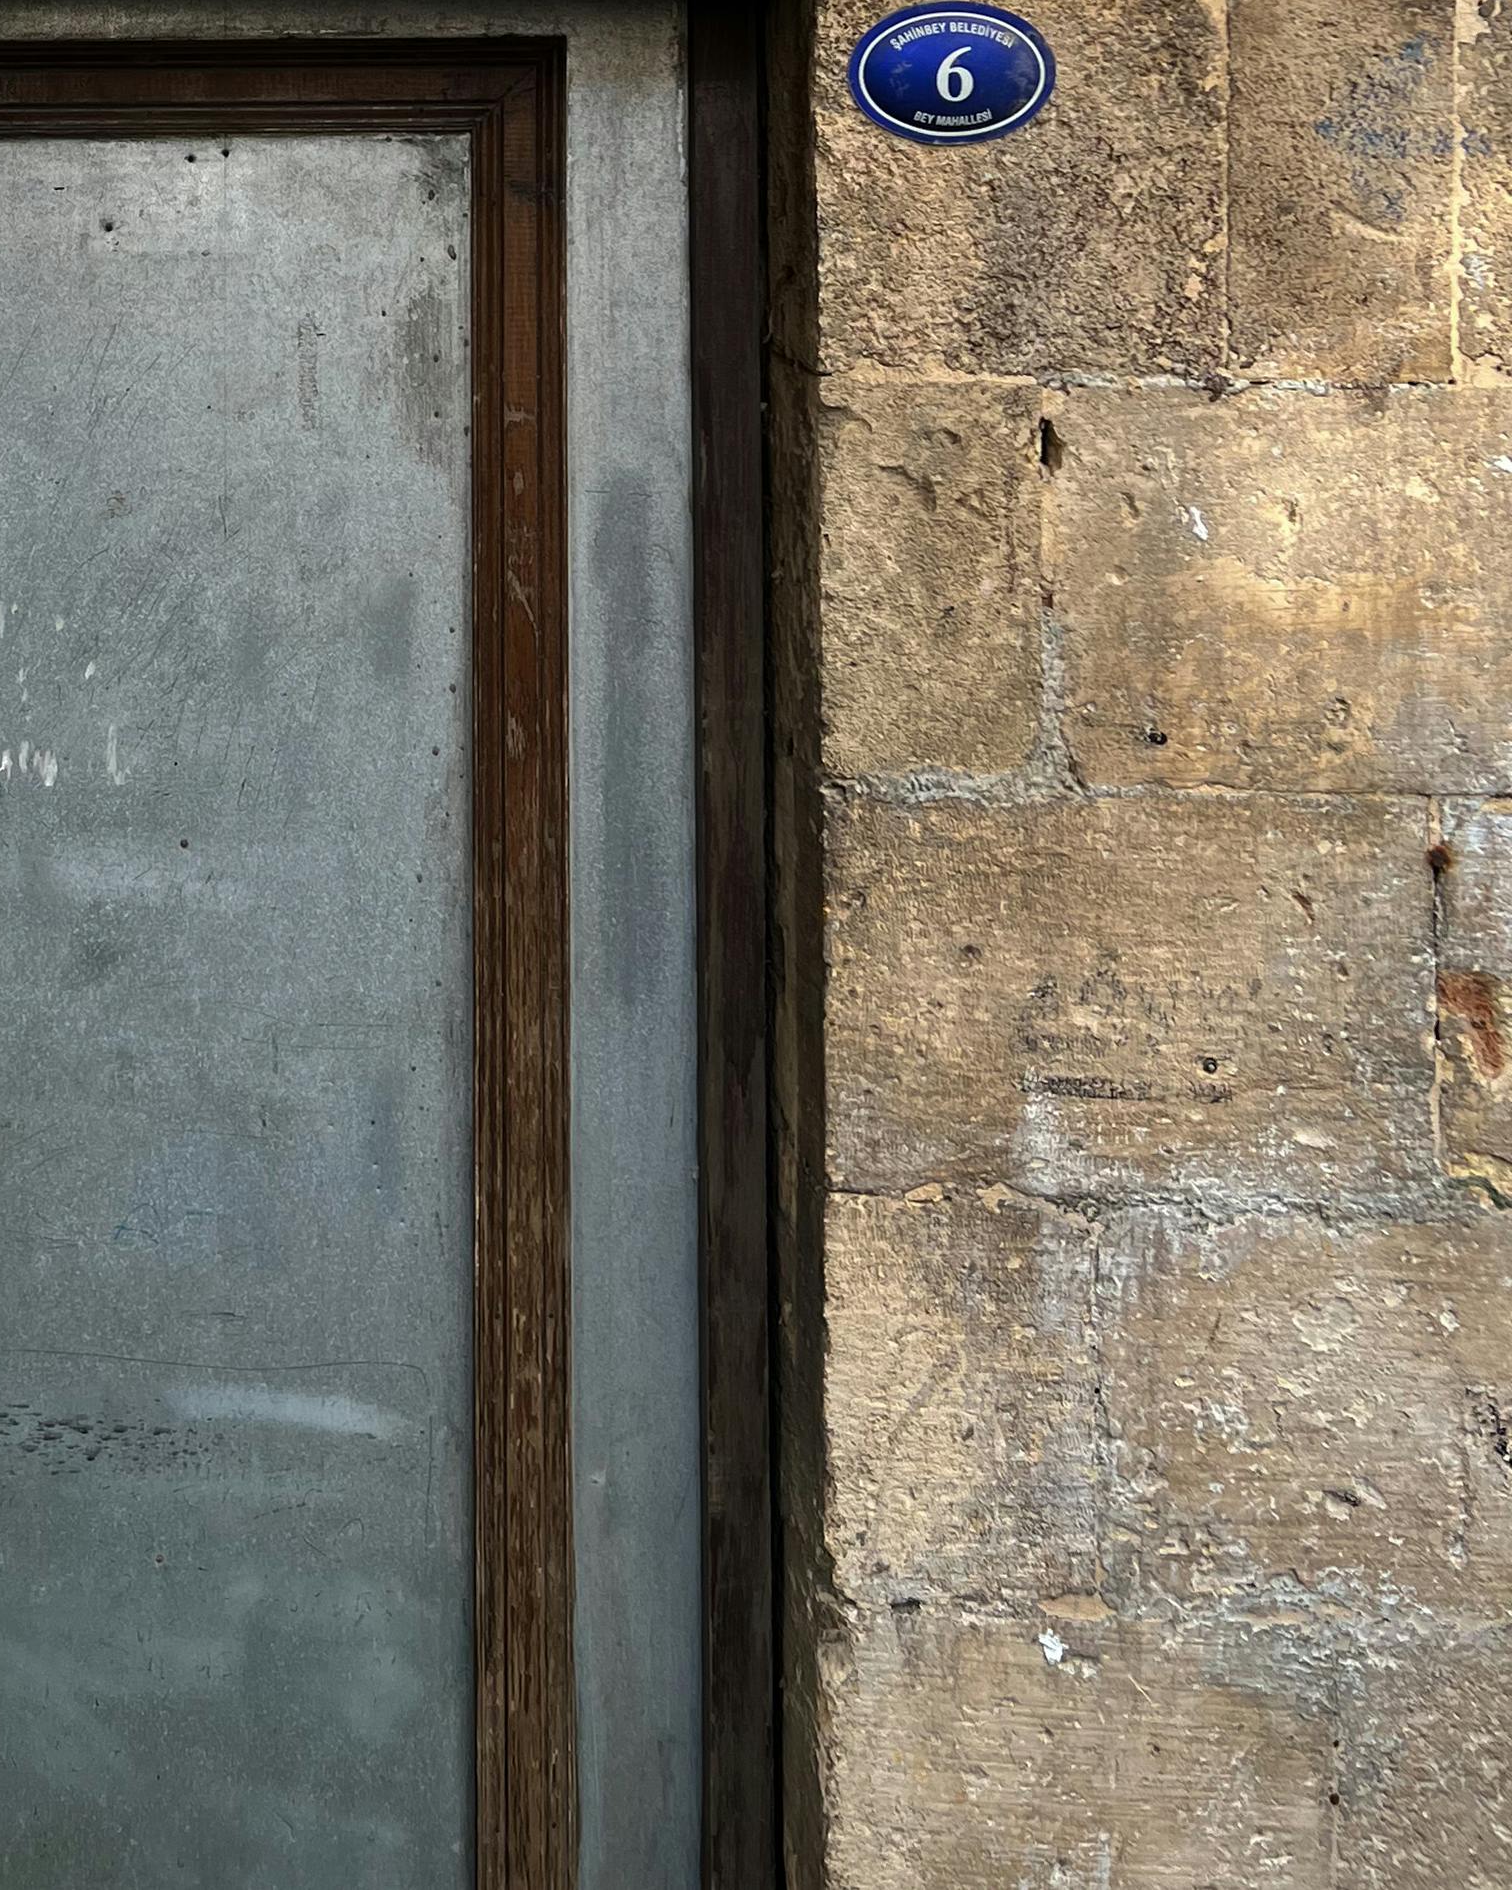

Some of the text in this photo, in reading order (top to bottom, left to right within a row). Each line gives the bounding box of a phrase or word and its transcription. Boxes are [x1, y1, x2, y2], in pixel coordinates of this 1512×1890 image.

[889, 21, 1015, 51] ŞAHİNBEY BELEDİYESİ
[936, 46, 974, 102] 6
[913, 108, 992, 126] BEY MAHALLESİ
